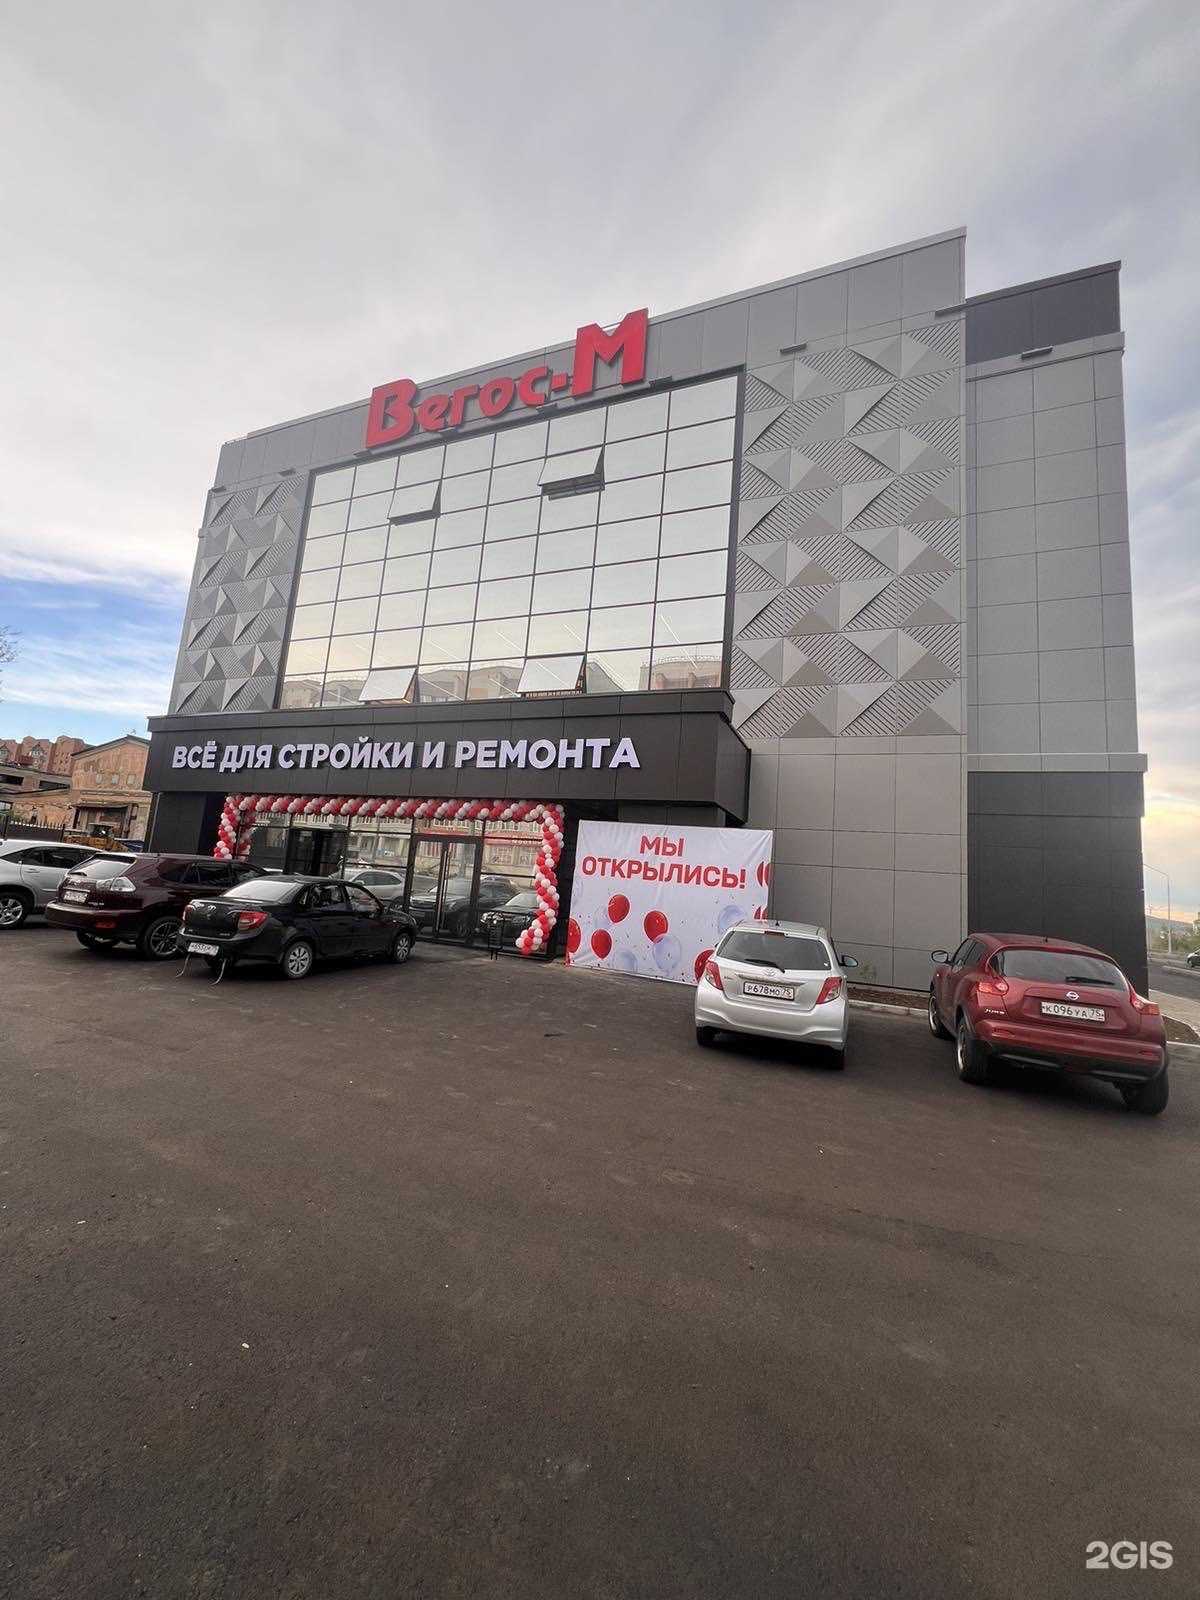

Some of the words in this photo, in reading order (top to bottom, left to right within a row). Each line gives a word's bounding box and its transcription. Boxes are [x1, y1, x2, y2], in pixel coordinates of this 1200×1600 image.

[365, 306, 650, 449] Вегос-М
[171, 740, 218, 769] ВСЁ
[218, 744, 273, 773] ДЛЯ
[277, 736, 415, 769] СТРОЙКИ
[421, 740, 446, 769] И
[454, 737, 641, 770] РЕМОНТА
[639, 835, 685, 857] МЫ
[582, 856, 747, 889] ОТКРЫЛИСЬ!
